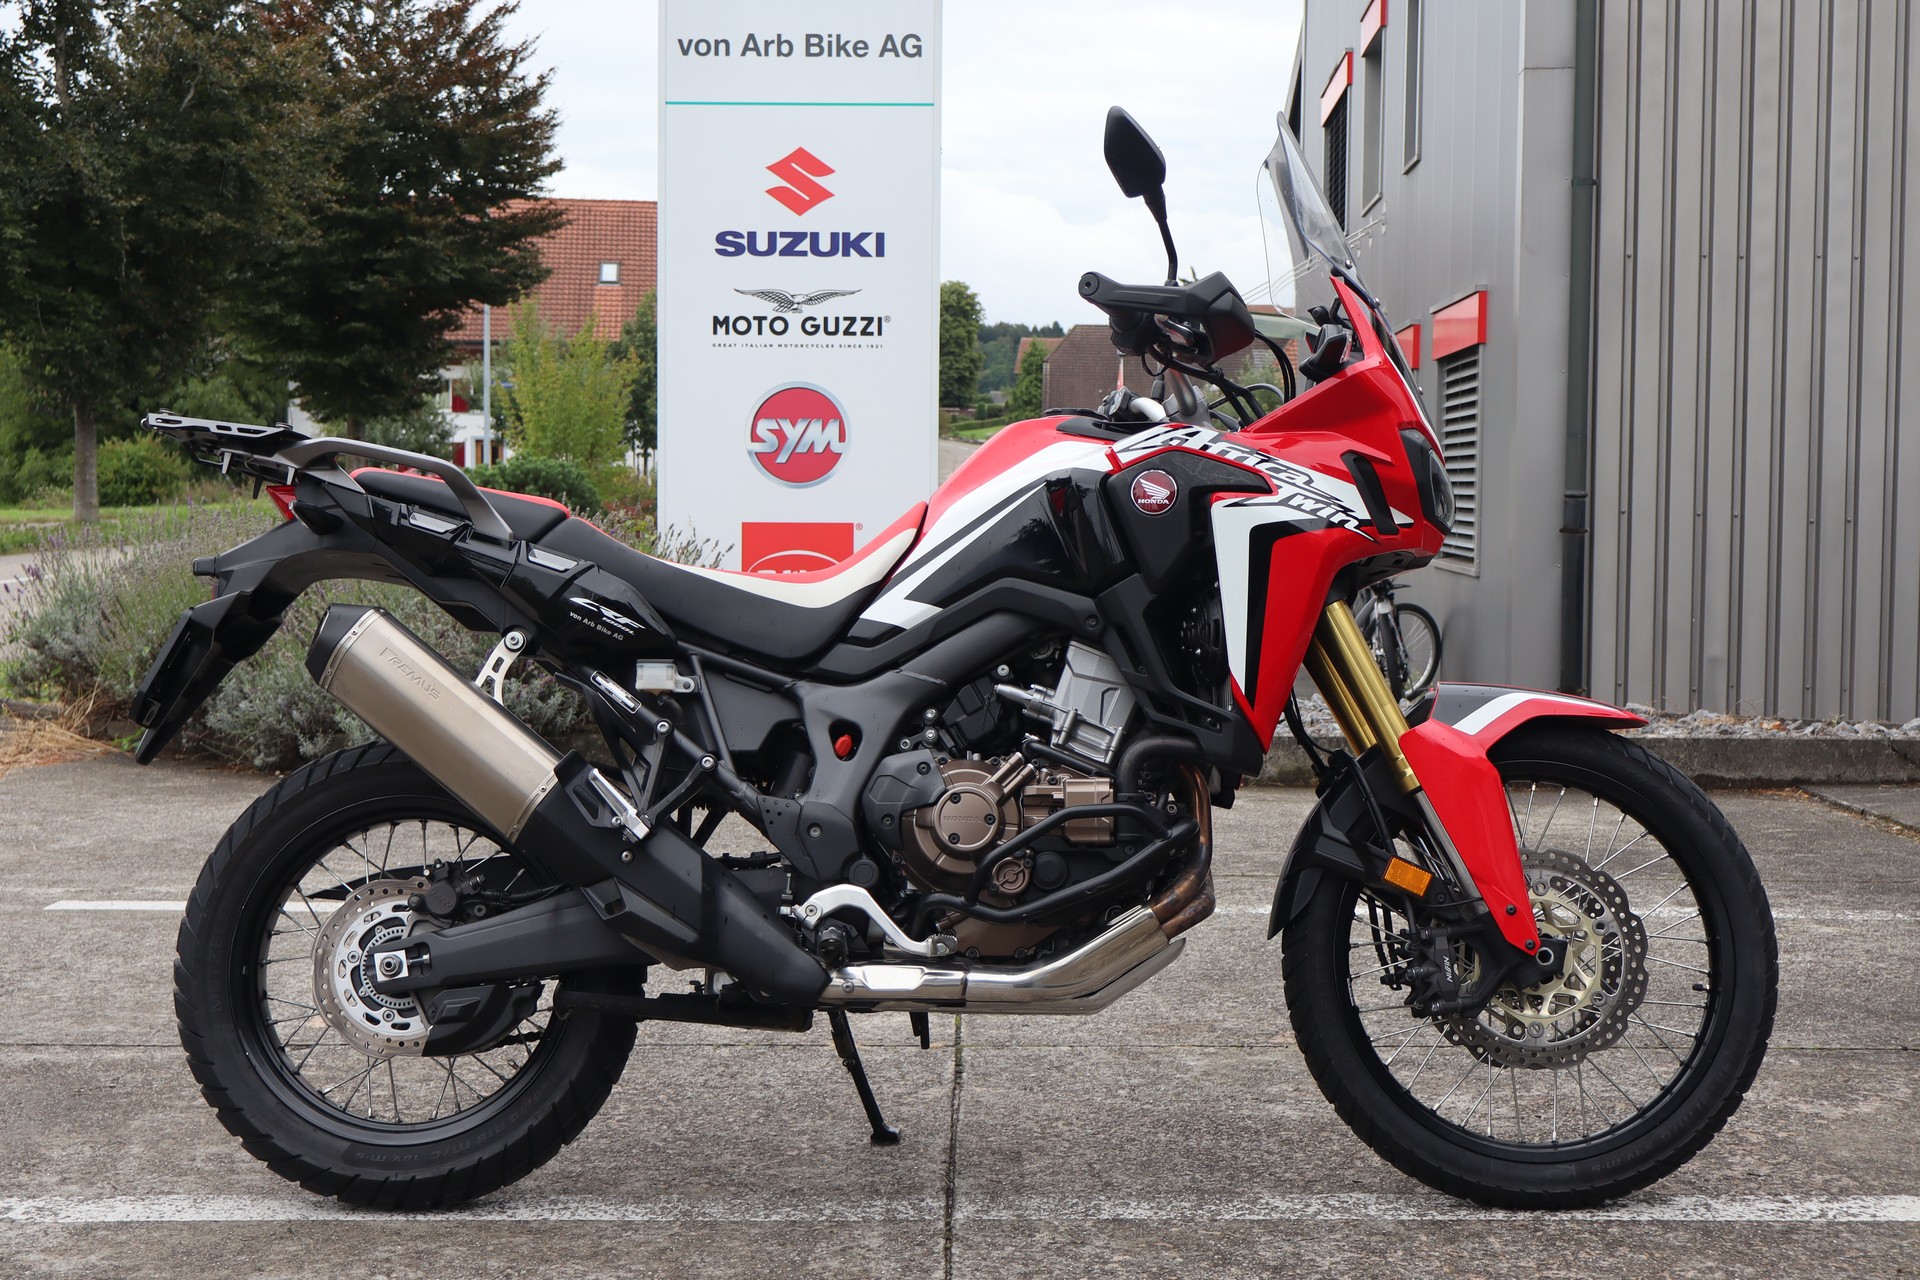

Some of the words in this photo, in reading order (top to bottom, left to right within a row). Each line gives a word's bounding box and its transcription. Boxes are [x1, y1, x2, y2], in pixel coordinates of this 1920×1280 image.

[677, 38, 730, 57] von
[740, 33, 794, 58] Arb
[804, 33, 870, 58] Bike
[878, 34, 923, 58] AG
[714, 230, 885, 258] SUZUKI
[712, 315, 790, 336] MOTO
[800, 316, 883, 336] GUZZI
[747, 418, 848, 464] SYM
[569, 597, 646, 629] CRF
[569, 611, 582, 621] von
[583, 618, 596, 628] Arb
[596, 624, 612, 636] Bike
[612, 632, 624, 641] AG
[386, 654, 441, 700] REMUS
[943, 815, 982, 823] HONDA
